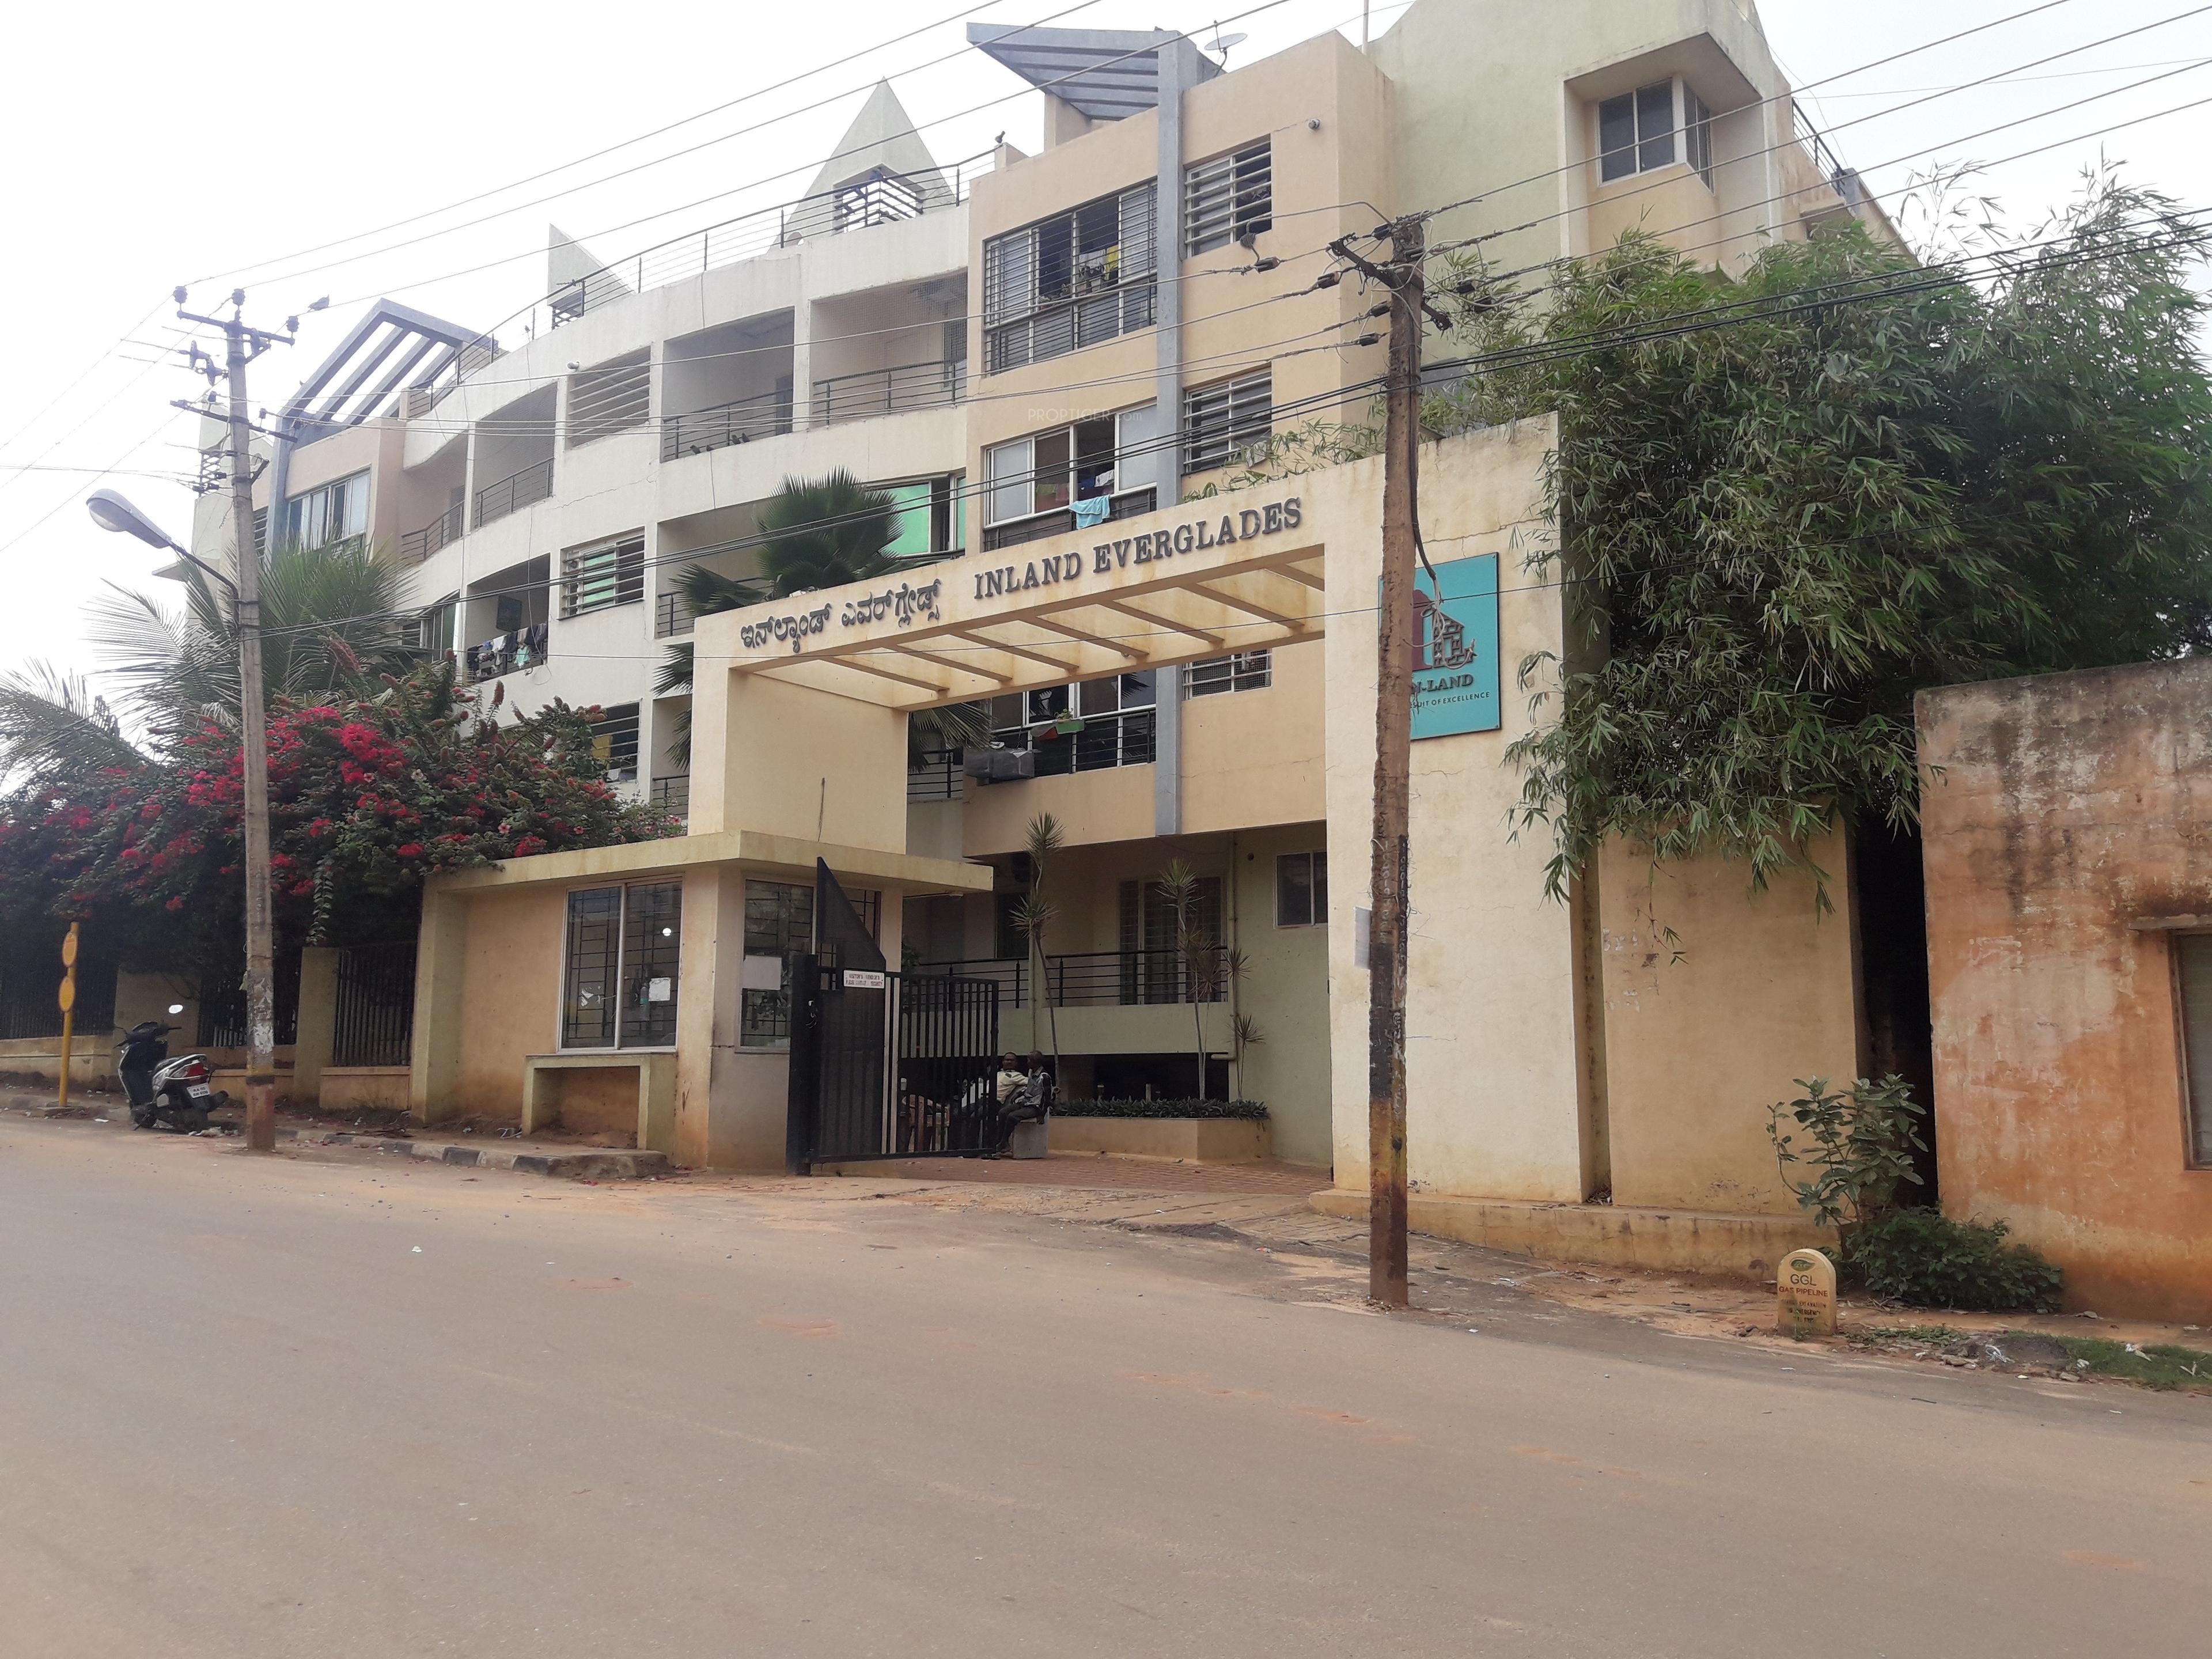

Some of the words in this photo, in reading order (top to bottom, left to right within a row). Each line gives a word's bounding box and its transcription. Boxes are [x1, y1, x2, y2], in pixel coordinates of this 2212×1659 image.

[974, 552, 1082, 599] INLAND
[1093, 497, 1302, 573] EVERGLADES
[1443, 691, 1490, 704] EXCELLENCE
[1790, 1274, 1817, 1286] GGL
[1796, 1287, 1828, 1297] PIPELINE
